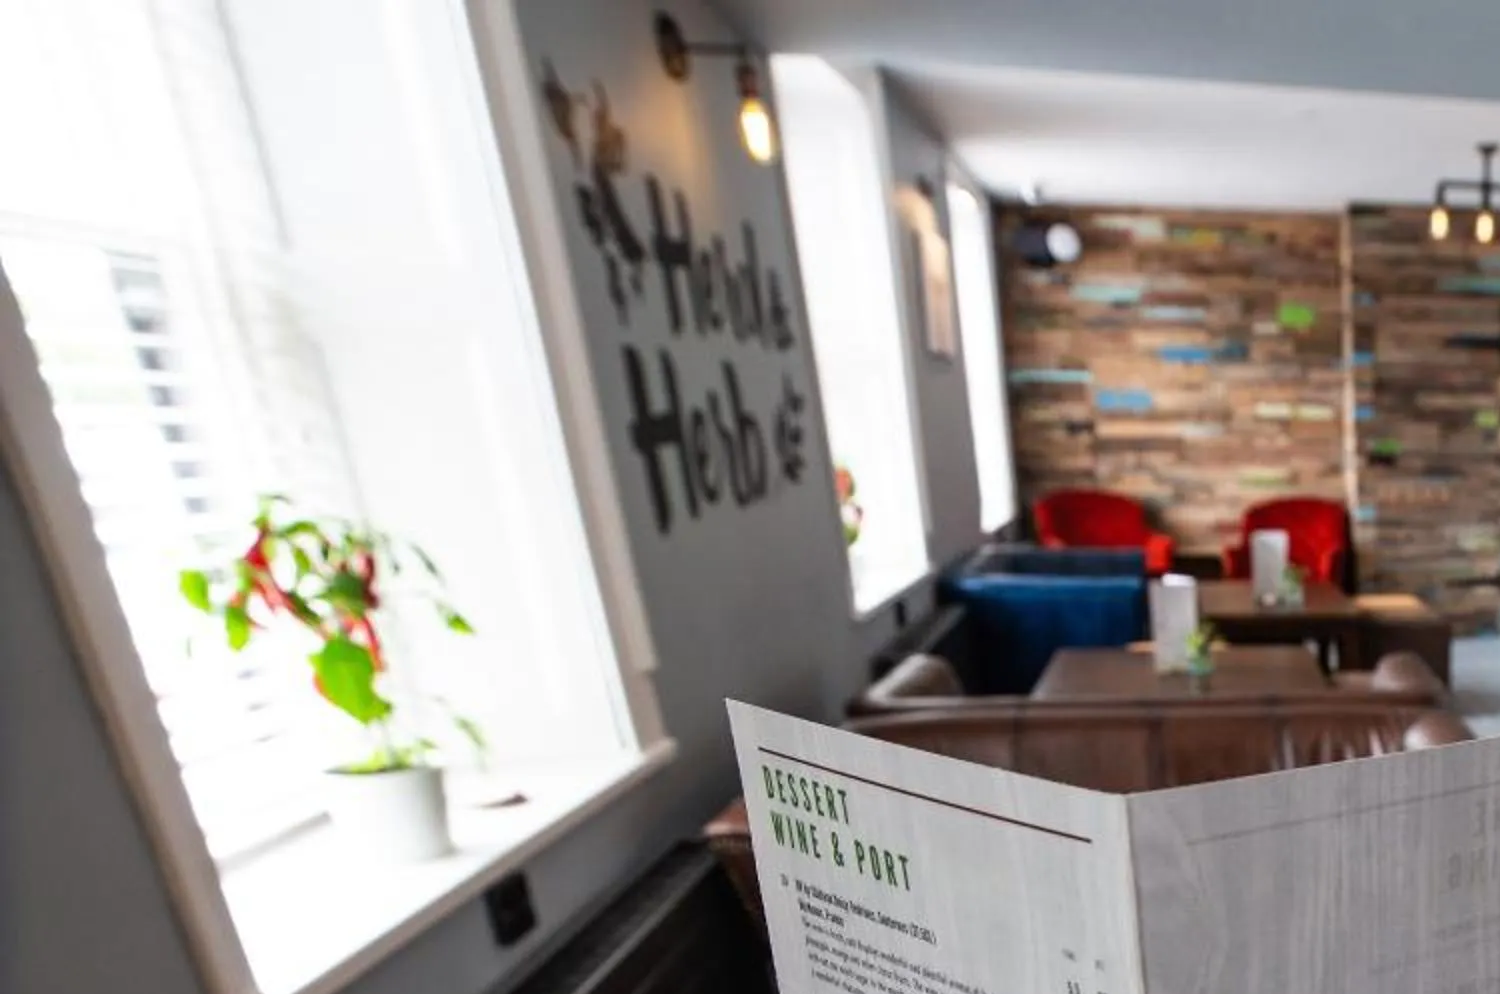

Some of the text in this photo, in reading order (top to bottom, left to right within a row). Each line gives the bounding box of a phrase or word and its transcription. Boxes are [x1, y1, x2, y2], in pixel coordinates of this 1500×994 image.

[646, 172, 768, 342] Herd
[622, 343, 768, 536] Herb
[761, 764, 850, 825] DESSERT
[769, 809, 911, 892] WINE & PORT
